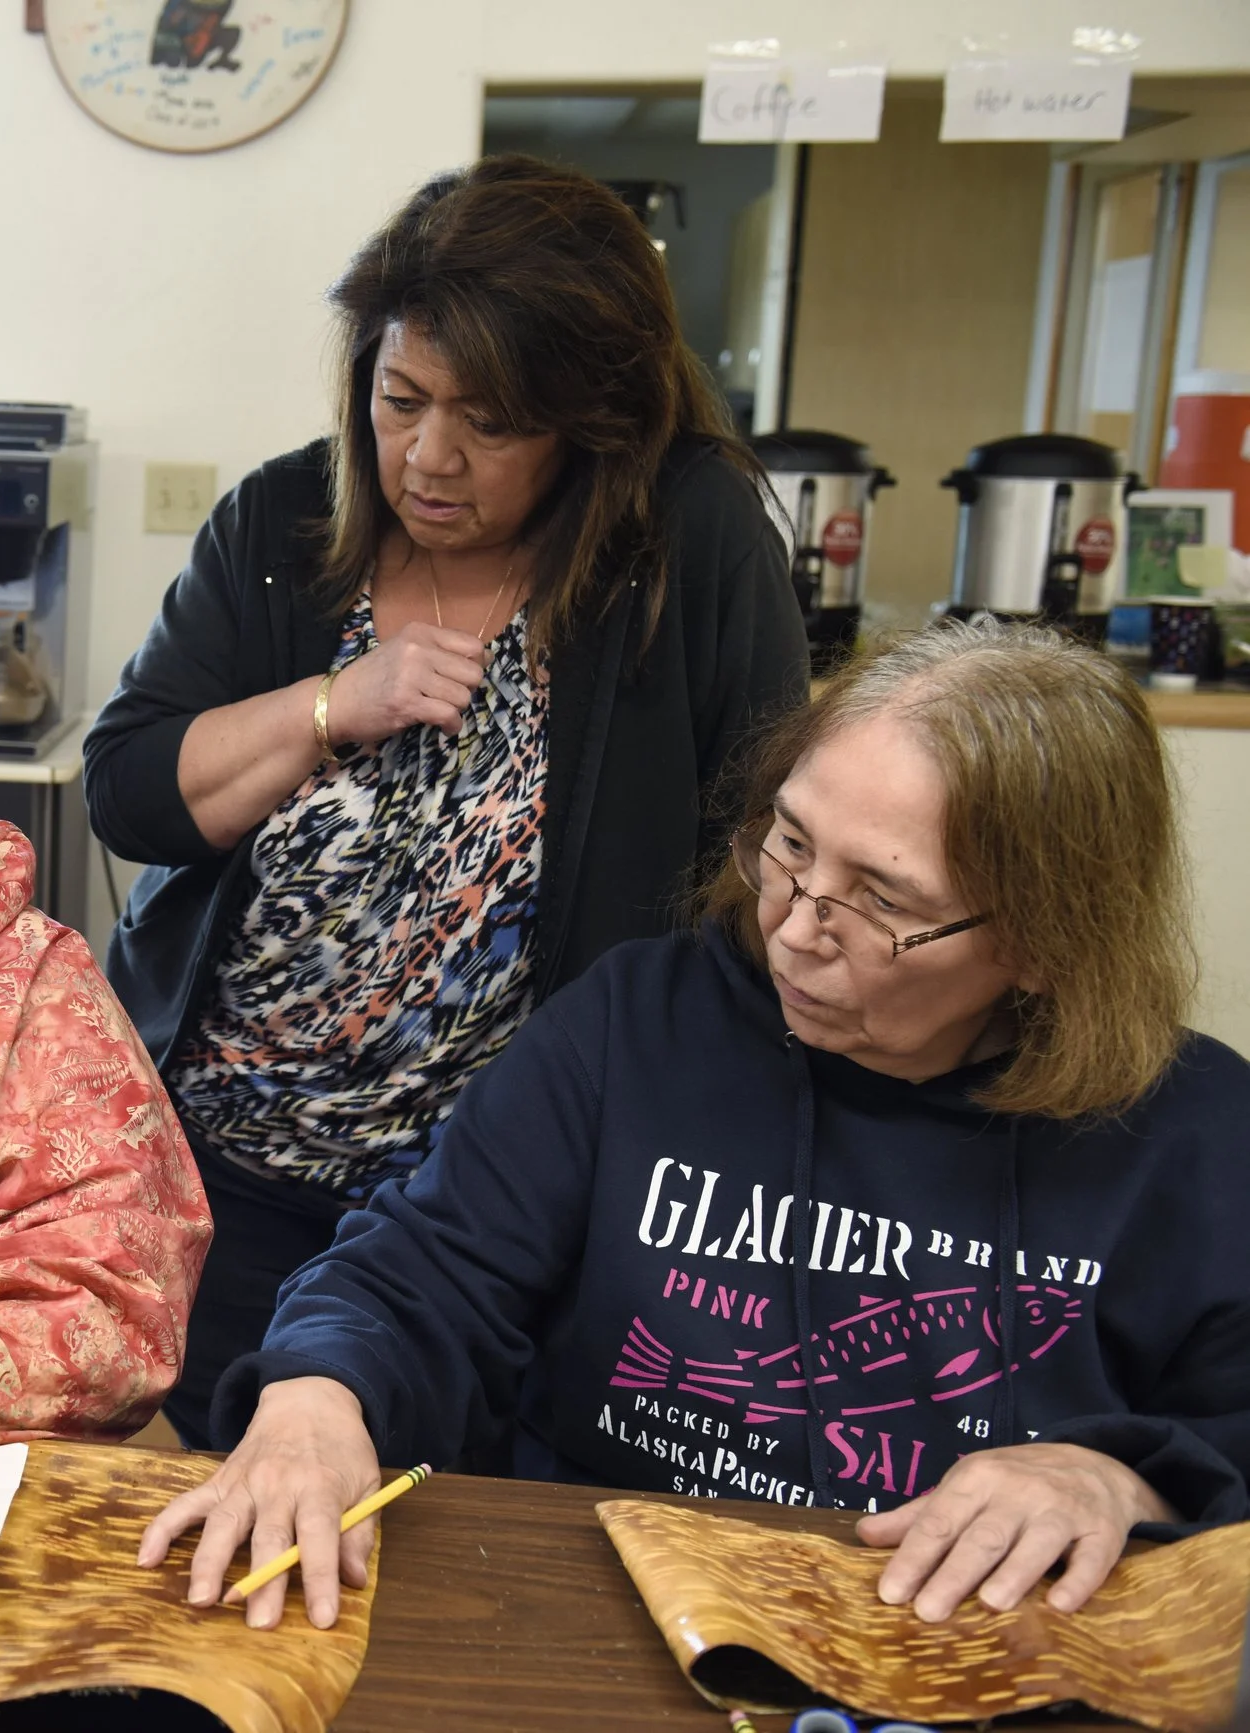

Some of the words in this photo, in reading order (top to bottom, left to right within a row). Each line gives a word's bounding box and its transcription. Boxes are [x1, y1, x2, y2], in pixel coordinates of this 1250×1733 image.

[711, 81, 818, 126] Coffee
[638, 1157, 913, 1281] GLACIER
[662, 1267, 771, 1329] PINK
[634, 1394, 730, 1440] PACKED
[747, 1432, 780, 1456] BY
[957, 1415, 990, 1438] 48
[824, 1421, 940, 1498] SAL
